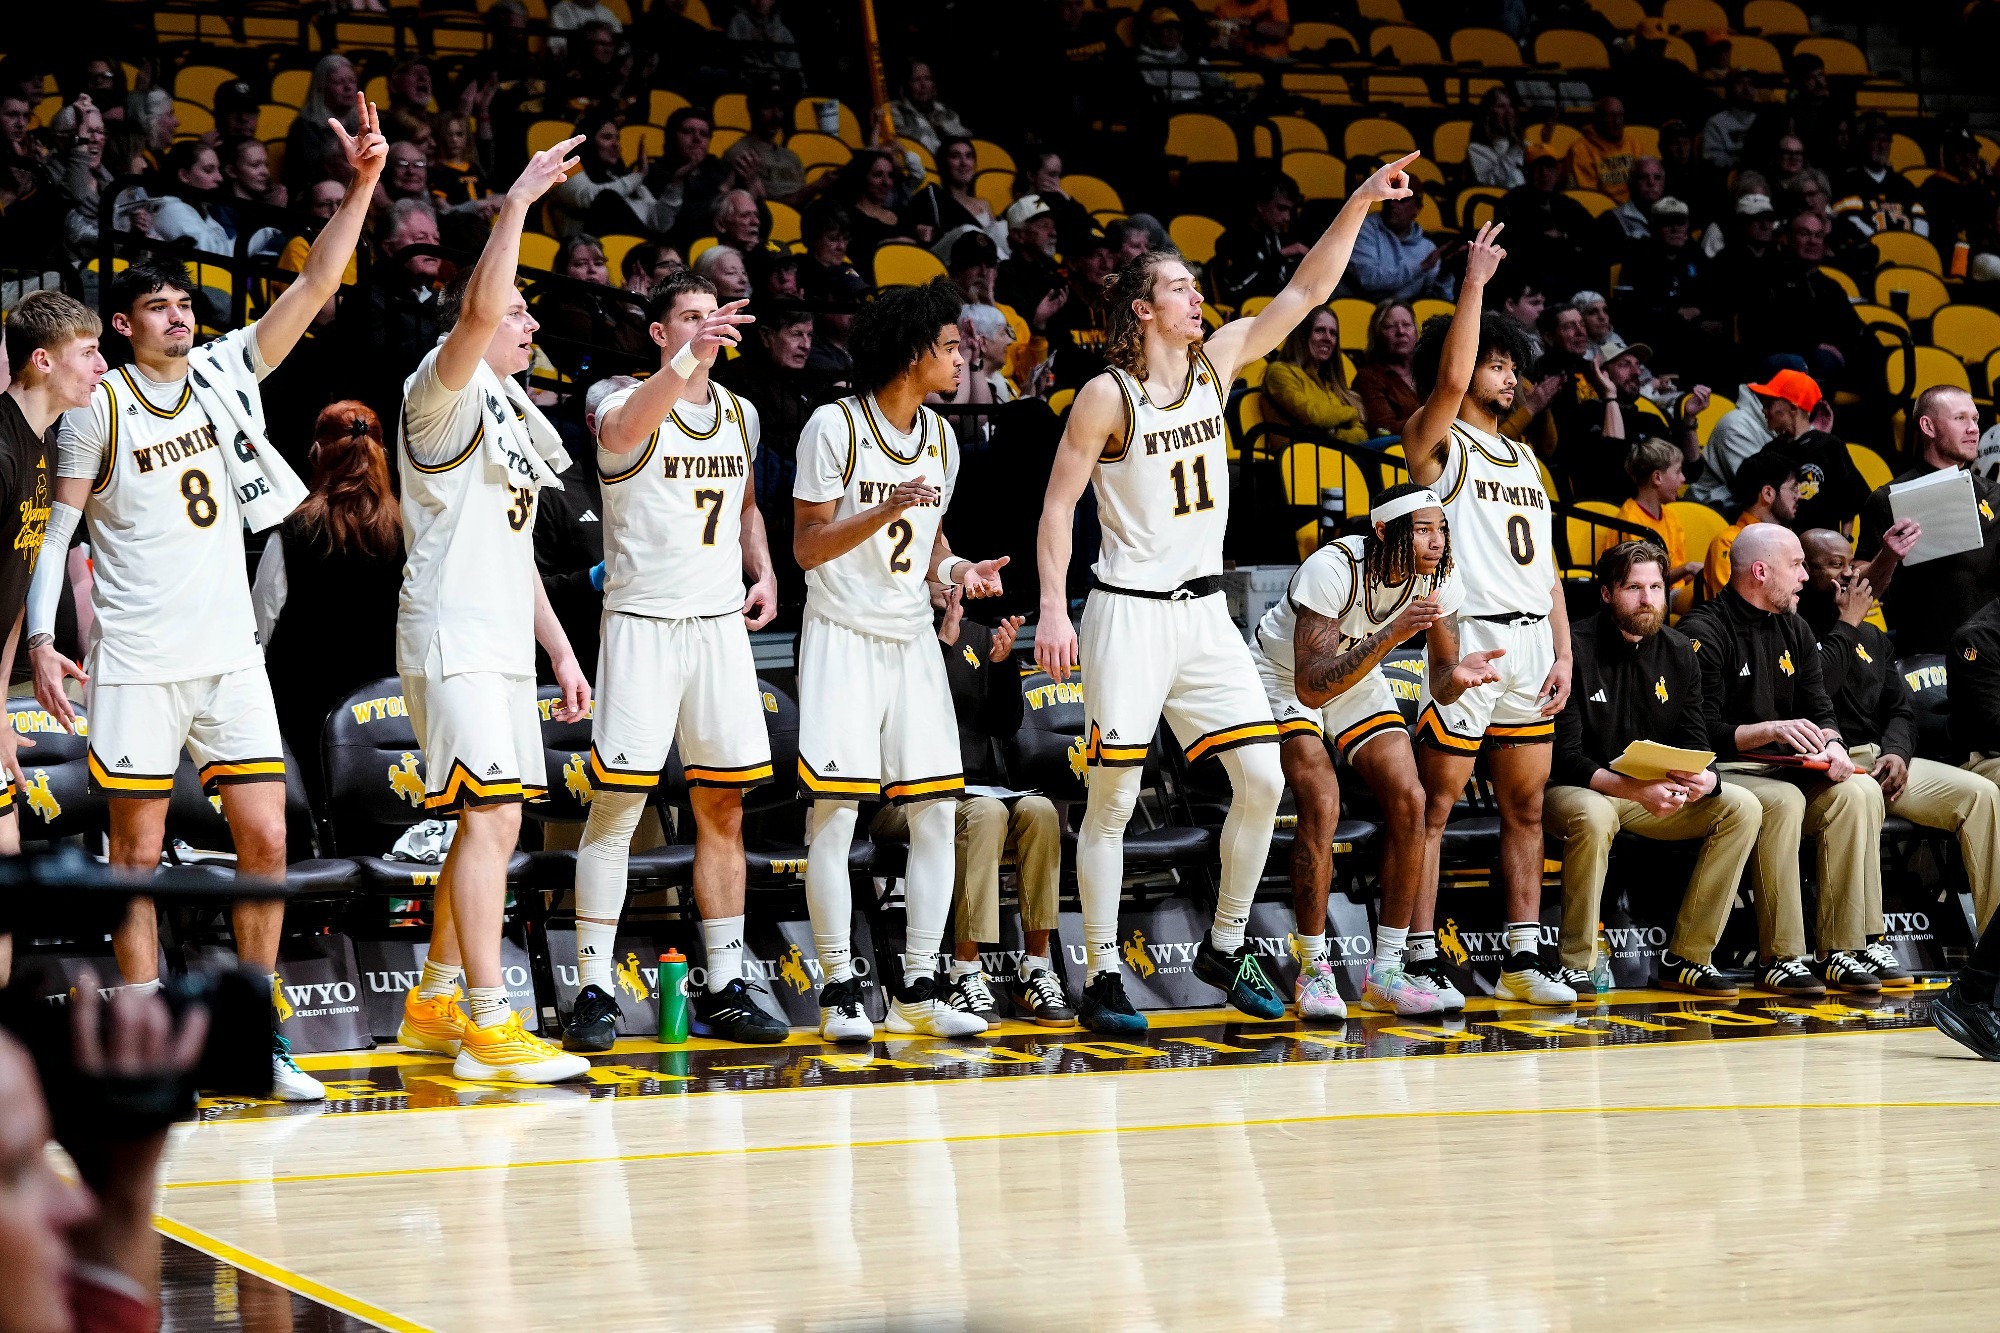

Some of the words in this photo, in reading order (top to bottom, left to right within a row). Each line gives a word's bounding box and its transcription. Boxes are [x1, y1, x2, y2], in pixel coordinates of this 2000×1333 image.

[1143, 414, 1222, 457] WYOMING
[663, 455, 745, 480] WYOMING
[180, 468, 218, 528] 8
[1168, 454, 1215, 518] 11
[1474, 478, 1546, 512] WYOMING
[694, 489, 725, 546] 7
[886, 517, 914, 574] 2
[1507, 514, 1537, 567] 0
[1605, 926, 1667, 948] WYO
[1886, 934, 1910, 942] CREDIT
[1911, 933, 1934, 942] UNION
[1470, 953, 1497, 962] CREDIT
[1614, 950, 1643, 959] CREDIT
[1157, 965, 1186, 975] CREDIT
[285, 981, 356, 1008] WYO
[296, 1008, 328, 1018] CREDIT
[330, 1005, 360, 1016] UNION
